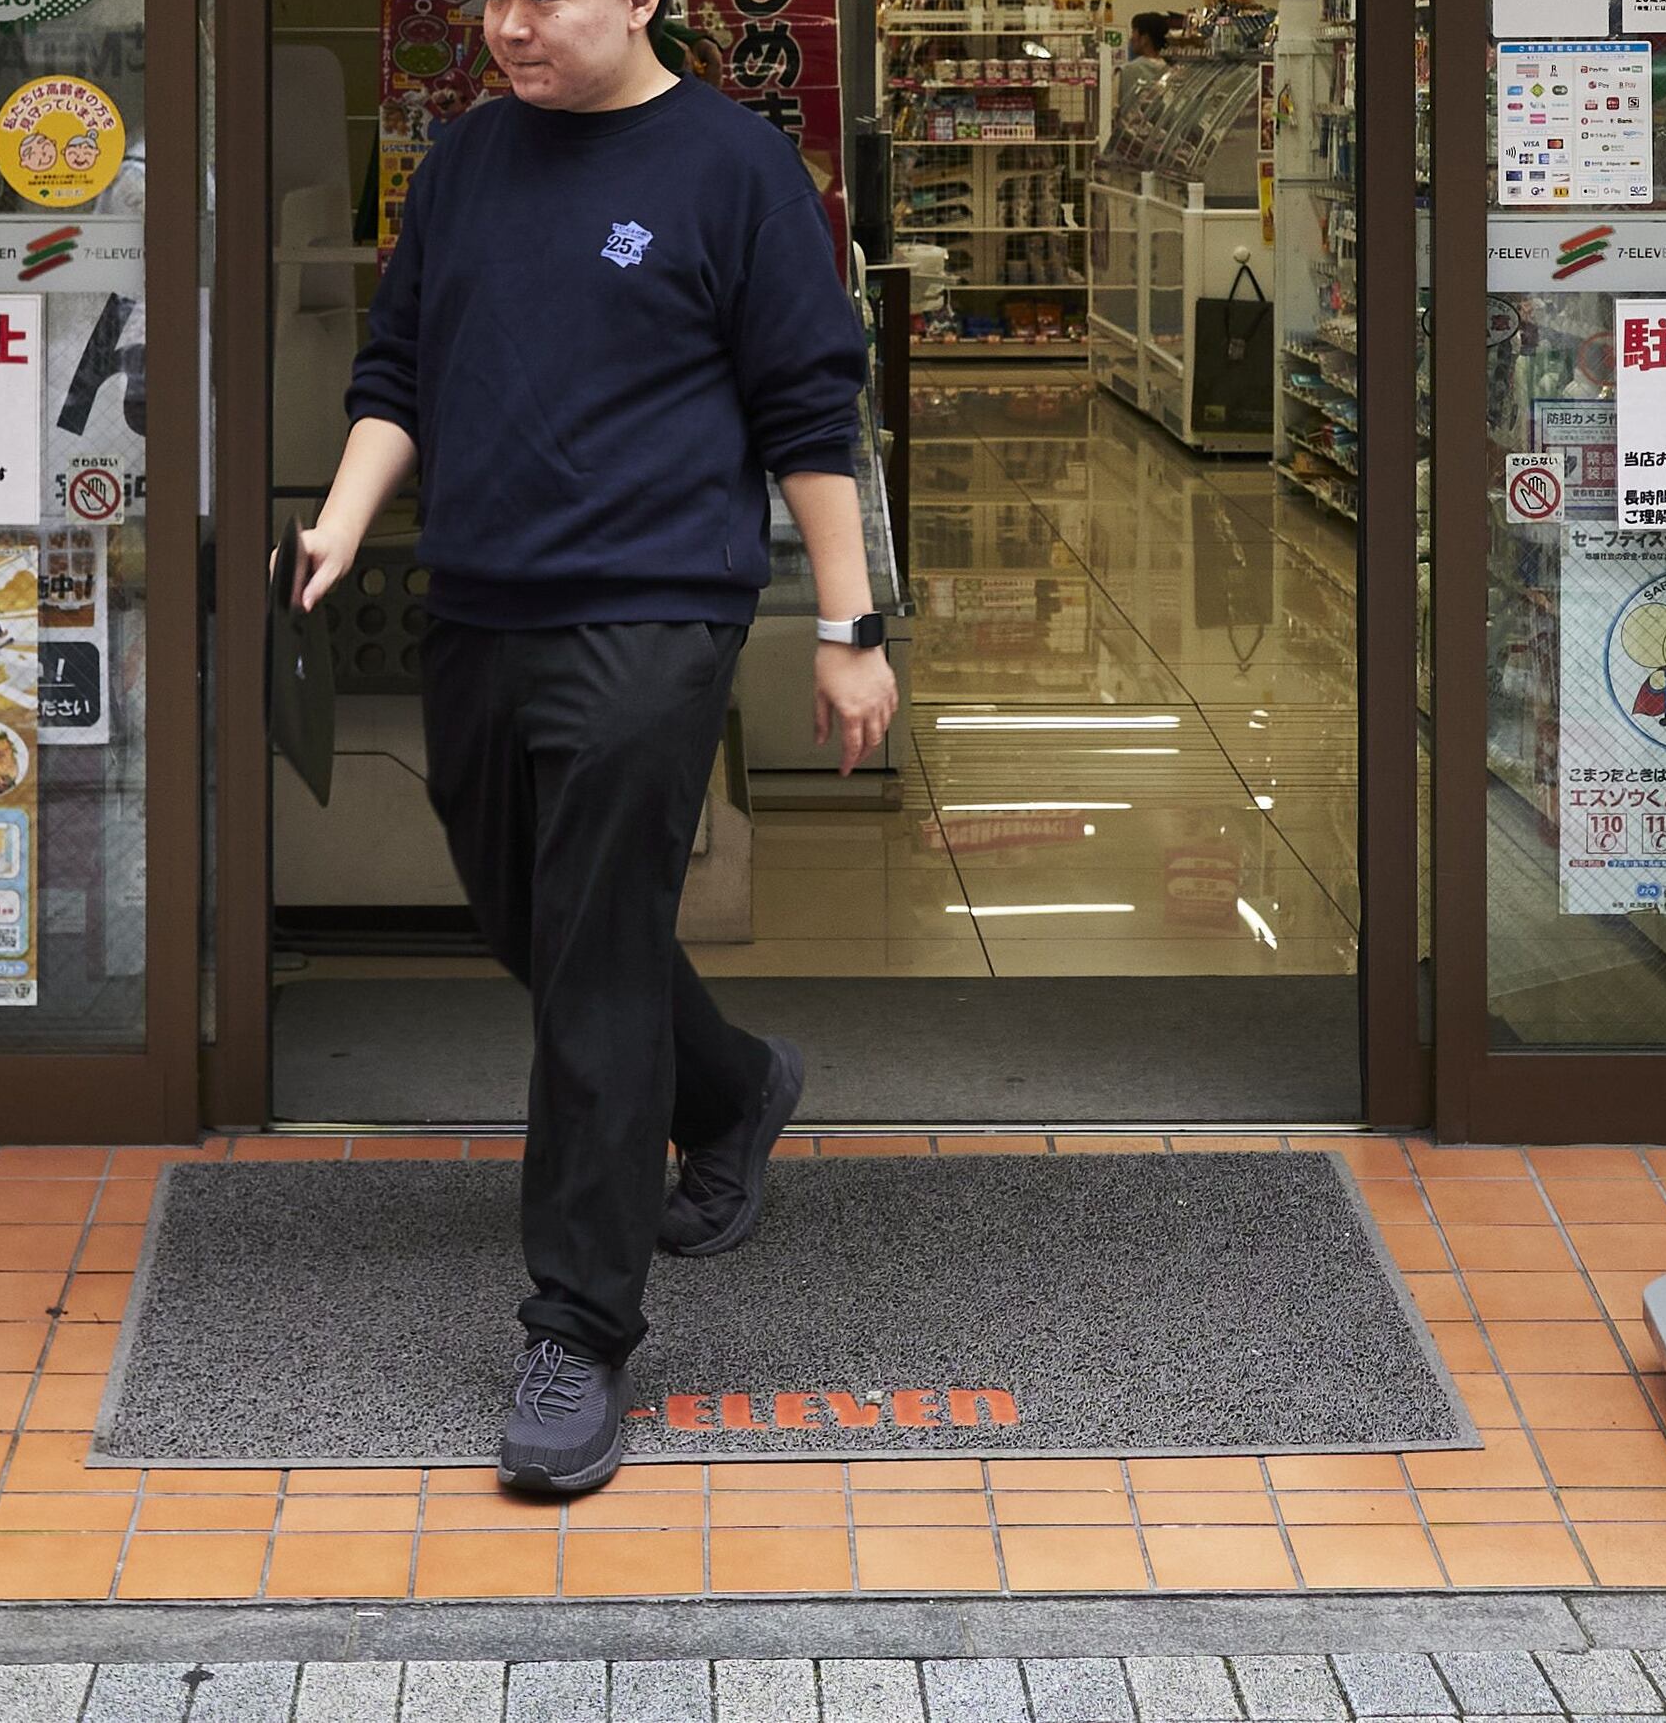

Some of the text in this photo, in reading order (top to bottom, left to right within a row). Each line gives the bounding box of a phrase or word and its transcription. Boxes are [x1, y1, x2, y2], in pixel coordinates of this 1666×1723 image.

[71, 457, 119, 468] さわらない
[1511, 457, 1559, 467] さわらない
[1590, 815, 1624, 833] 110
